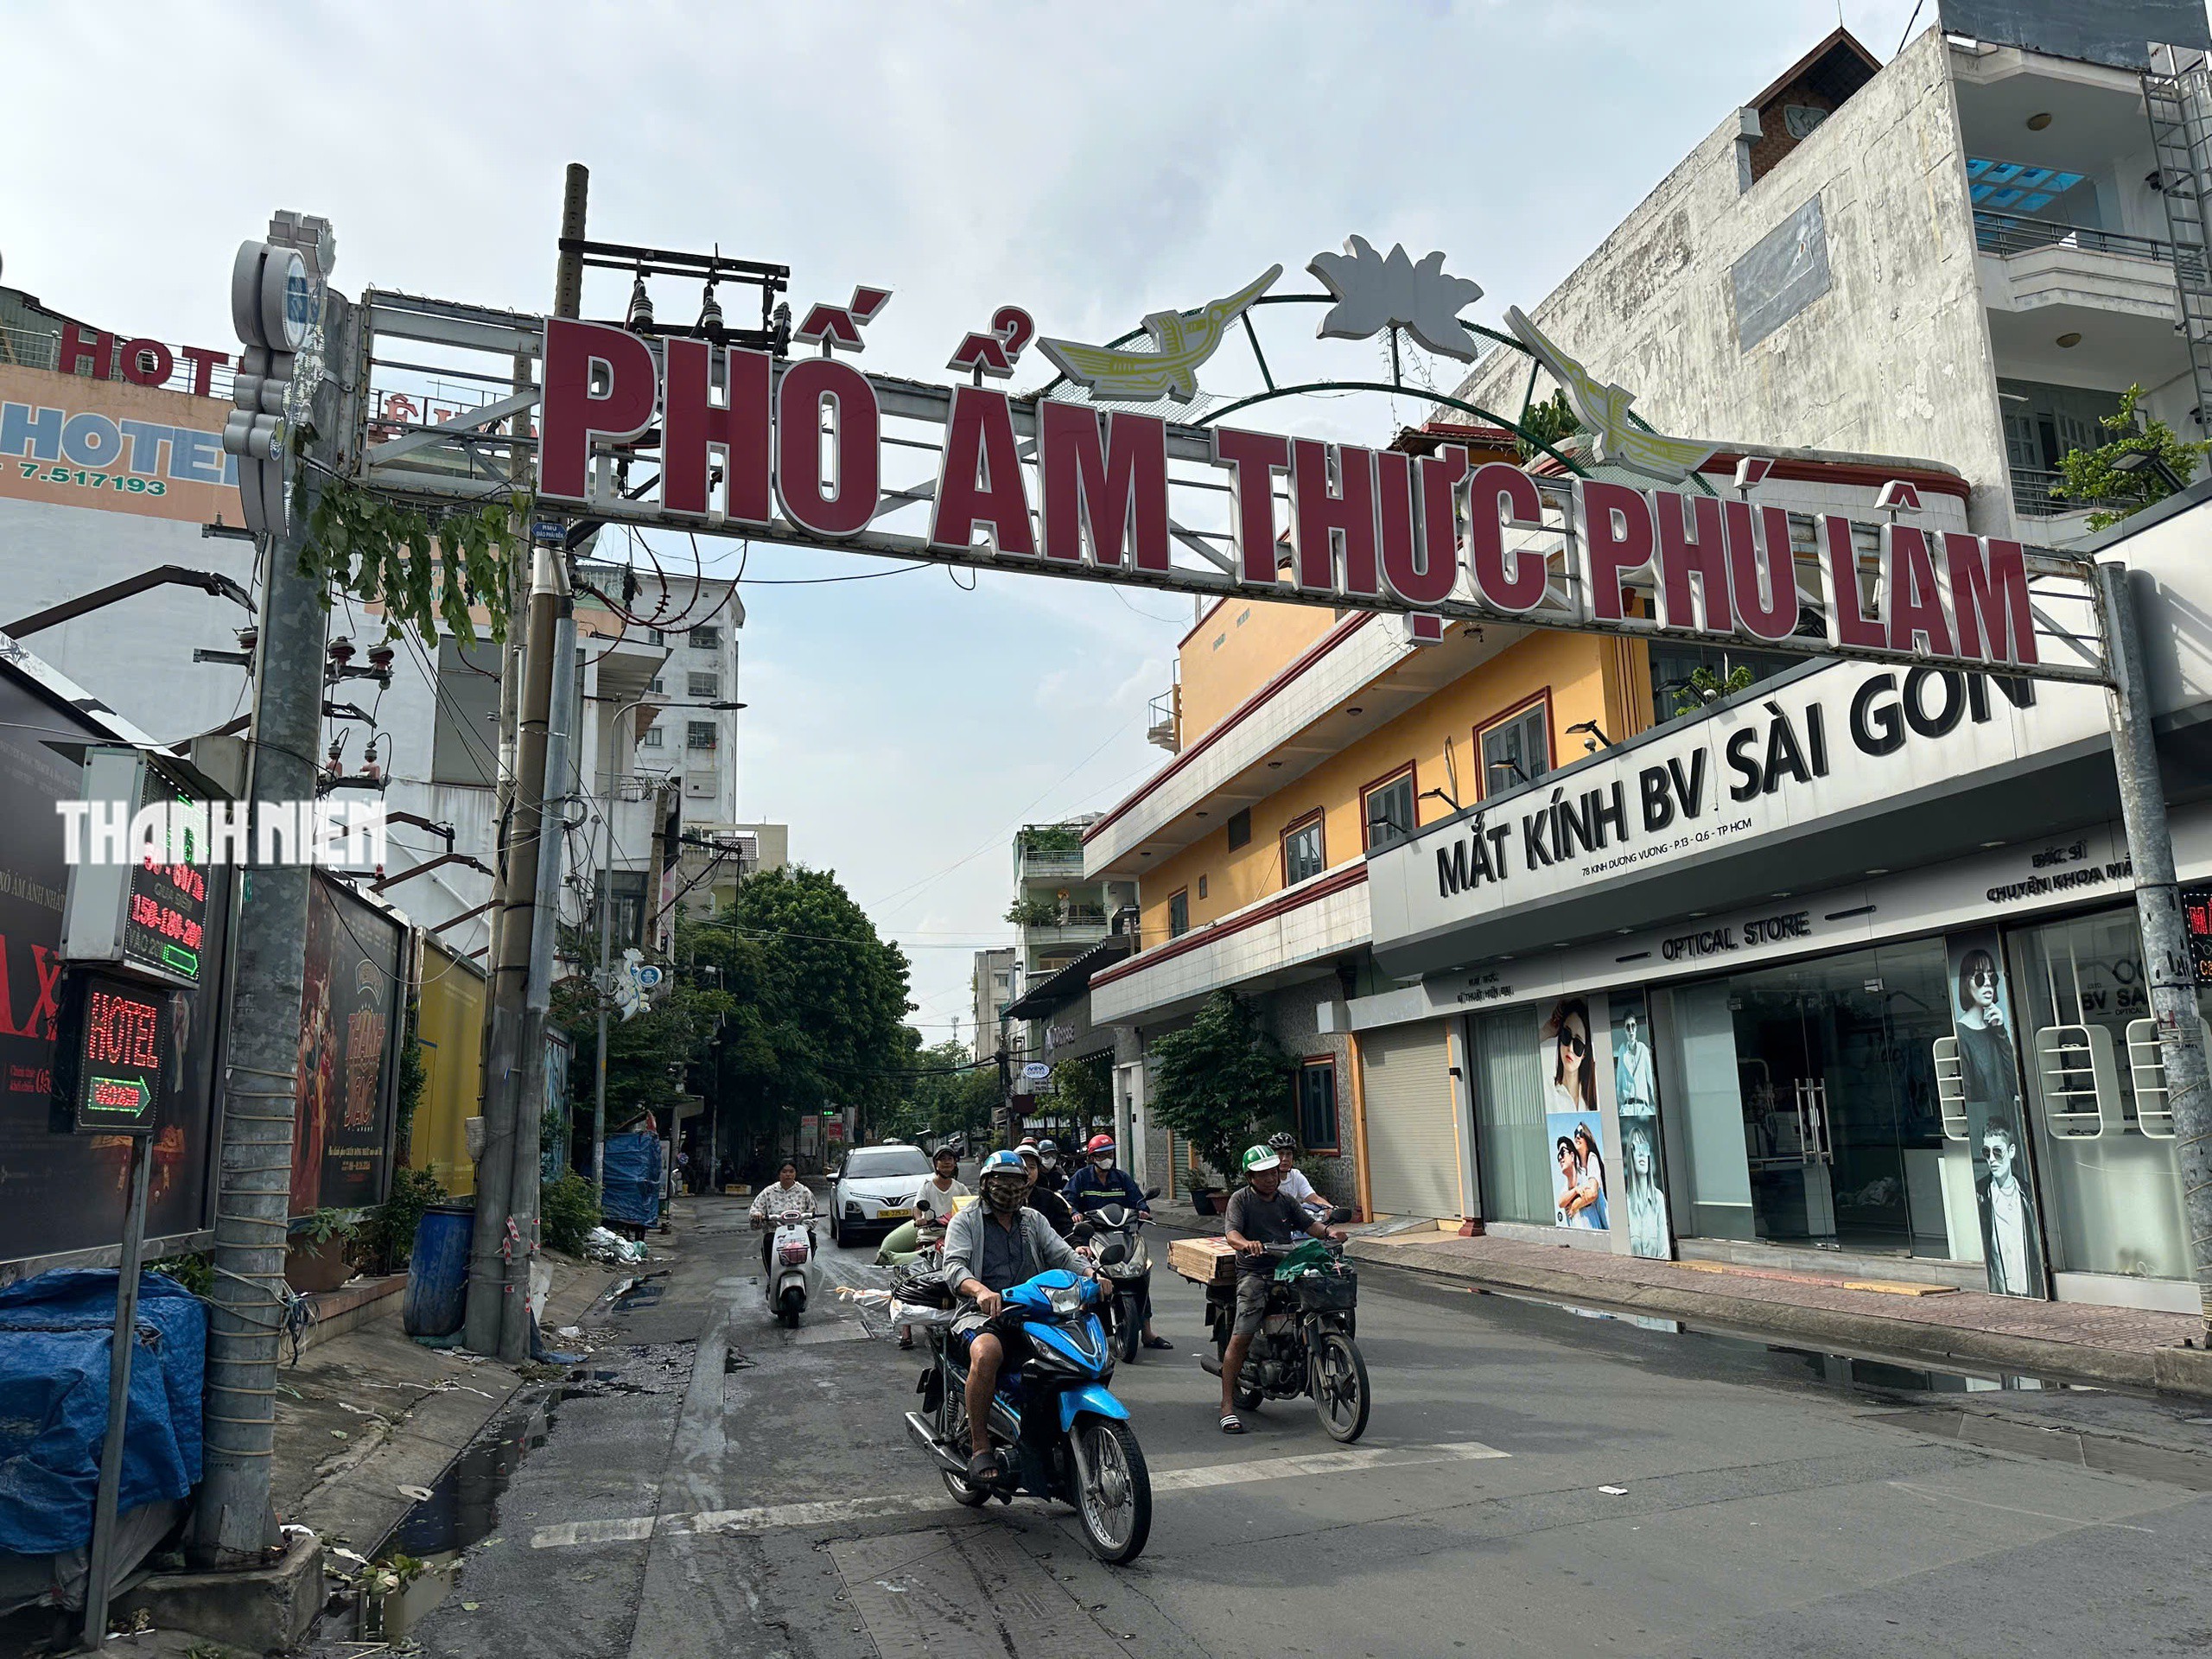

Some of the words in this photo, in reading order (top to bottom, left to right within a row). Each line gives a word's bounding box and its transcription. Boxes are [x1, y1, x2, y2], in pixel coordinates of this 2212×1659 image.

[58, 323, 245, 397] HOT
[18, 462, 167, 496] 7.517193
[537, 285, 893, 538] PHỐ
[926, 305, 1170, 576] ẨM
[1211, 425, 1548, 645] THỰC
[1573, 455, 1800, 642] PHÚ
[1815, 479, 2041, 668] LÂM
[1436, 811, 1510, 898] MẮT
[1522, 786, 1630, 870] KÍNH
[1639, 747, 1707, 832] BV
[1726, 701, 1829, 803] SÀI
[1581, 868, 1590, 877] 78
[1591, 862, 1608, 875] KINH
[1674, 837, 1689, 849] P.13
[1695, 830, 1710, 843] Q.6
[1716, 826, 1728, 836] TP
[1730, 817, 1752, 833] HCM
[2053, 867, 2106, 889] KHOA
[2106, 852, 2133, 879] MẮ
[1662, 927, 1738, 962] OPTICAL
[1744, 911, 1812, 946] STORE
[2081, 990, 2107, 1011] BV
[2115, 1007, 2145, 1016] OPTICAL
[88, 992, 159, 1068] HOTEL
